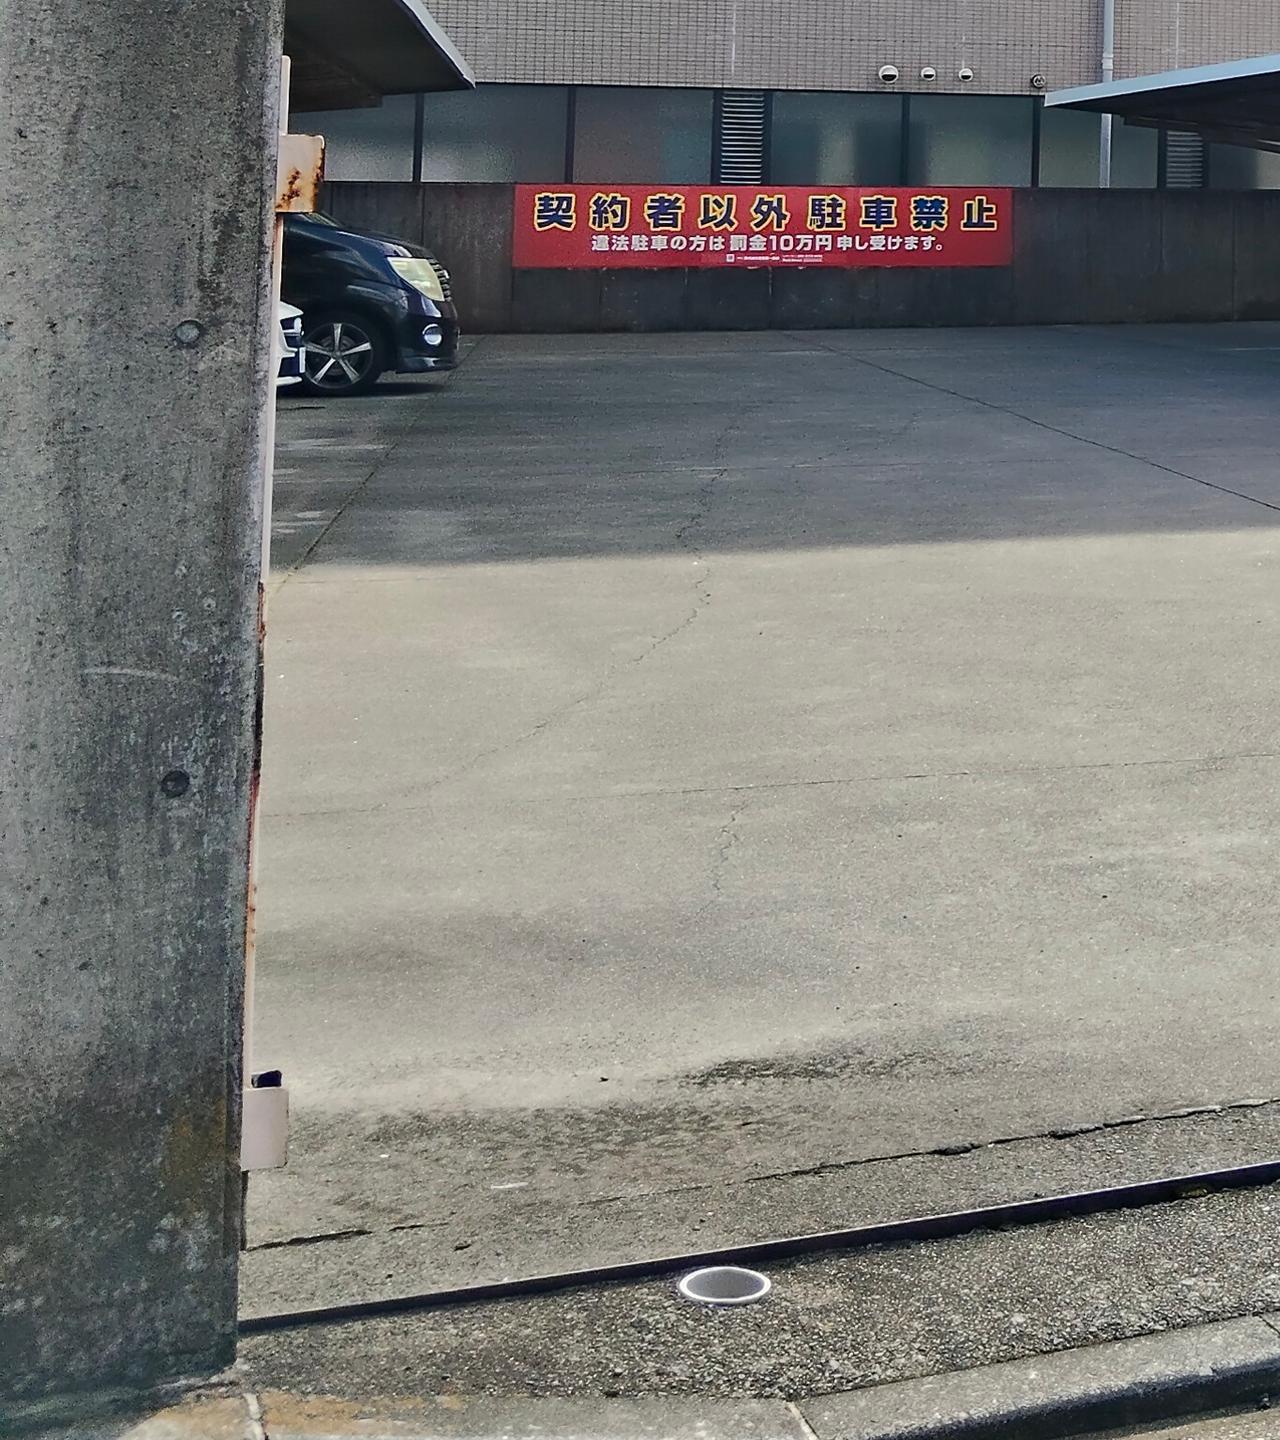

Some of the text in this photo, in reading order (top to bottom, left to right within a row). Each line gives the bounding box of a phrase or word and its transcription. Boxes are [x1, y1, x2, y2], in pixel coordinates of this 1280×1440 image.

[534, 192, 998, 232] 契約者以外駐車禁止
